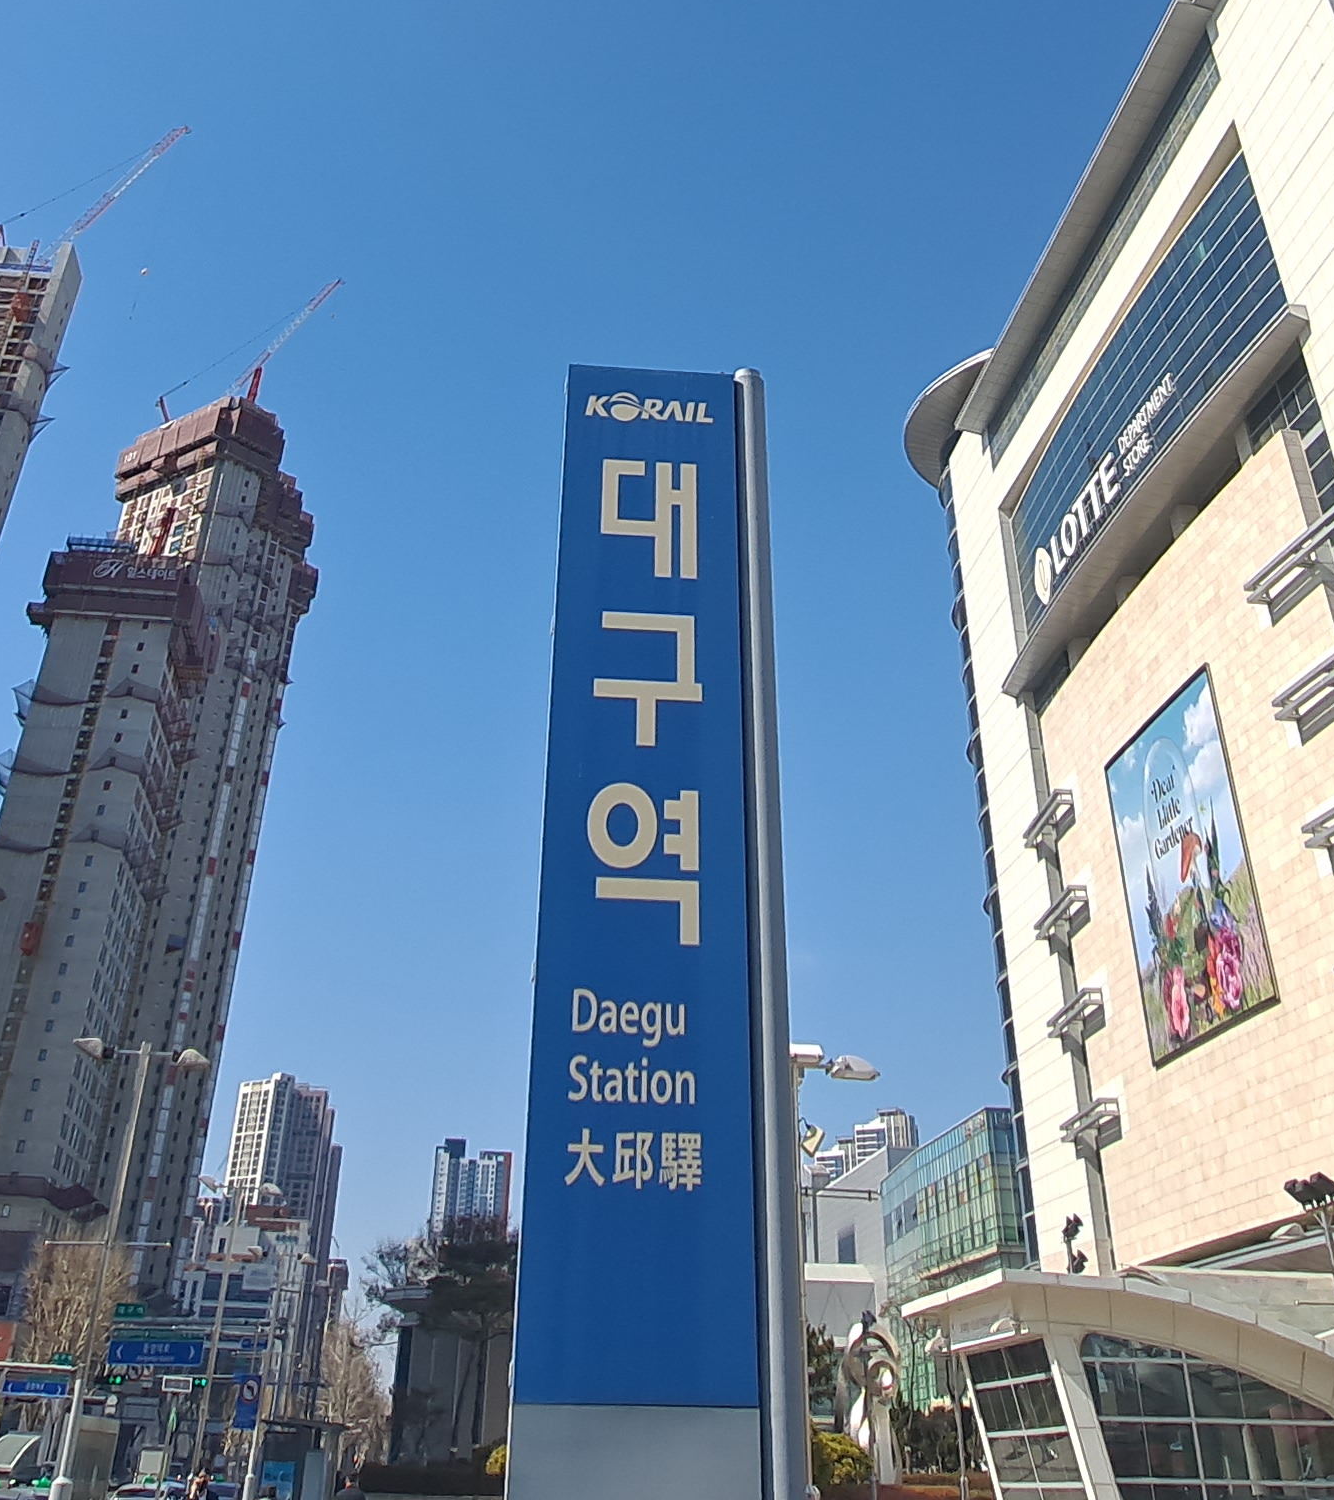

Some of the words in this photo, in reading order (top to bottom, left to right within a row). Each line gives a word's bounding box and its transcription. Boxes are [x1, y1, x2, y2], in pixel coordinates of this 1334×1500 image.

[584, 392, 714, 424] KORAIL
[1118, 372, 1174, 455] DEPARTMENT
[1123, 432, 1152, 477] STORE
[1051, 452, 1122, 576] LOTTE
[586, 458, 703, 946] 대구역
[571, 988, 686, 1048] Daegu
[567, 1054, 696, 1105] Station
[563, 1128, 703, 1192] 大邱驛
